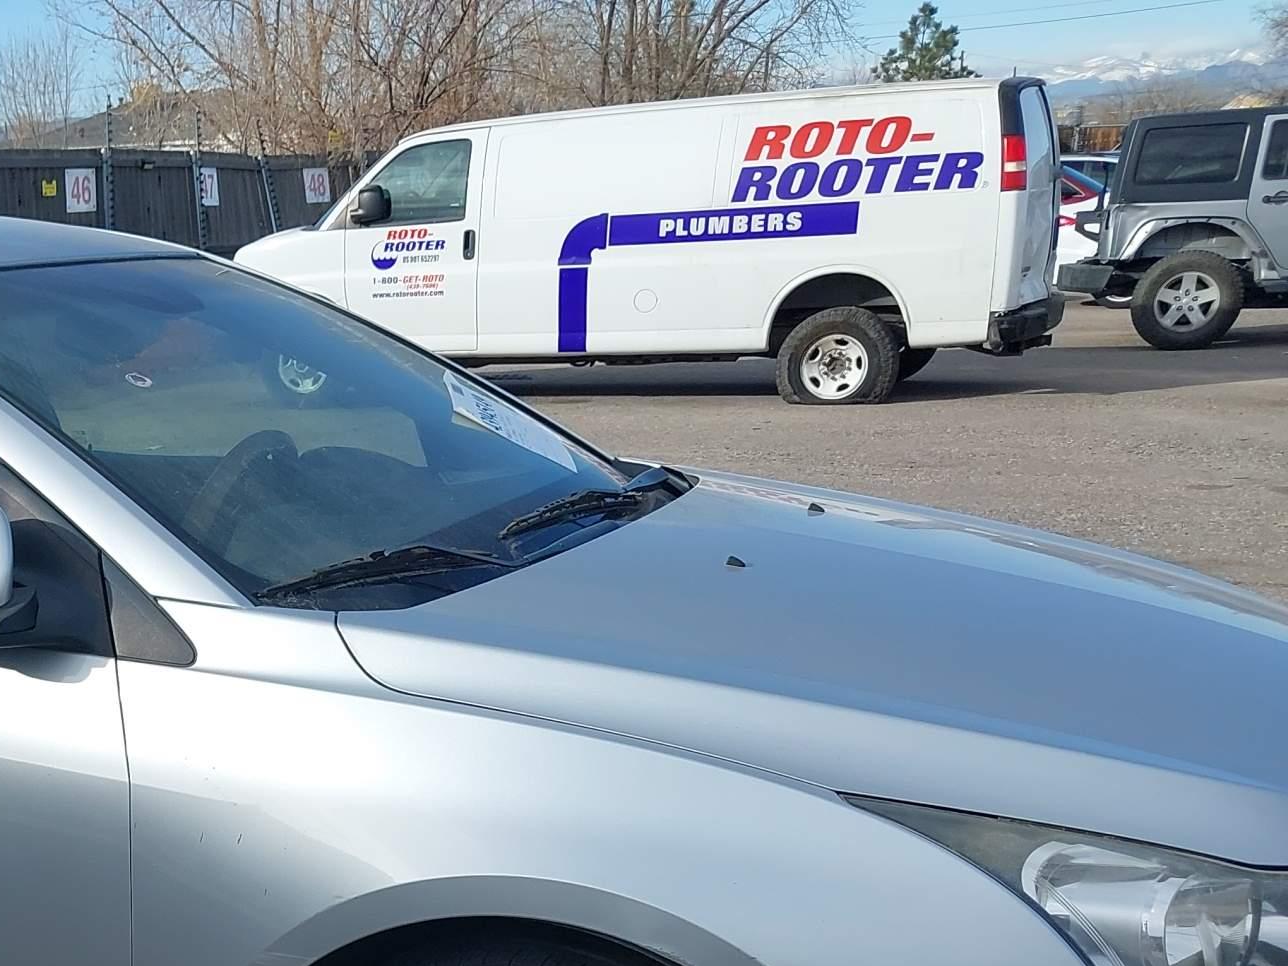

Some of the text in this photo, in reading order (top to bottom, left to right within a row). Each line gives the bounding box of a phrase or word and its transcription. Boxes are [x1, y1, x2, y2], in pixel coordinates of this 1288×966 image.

[744, 116, 935, 161] ROTO-
[72, 176, 91, 205] 46
[308, 173, 326, 197] 48
[731, 151, 985, 203] ROOTER
[387, 229, 433, 240] ROTO-
[659, 211, 803, 238] PLUMBERS
[384, 240, 445, 252] ROOTER
